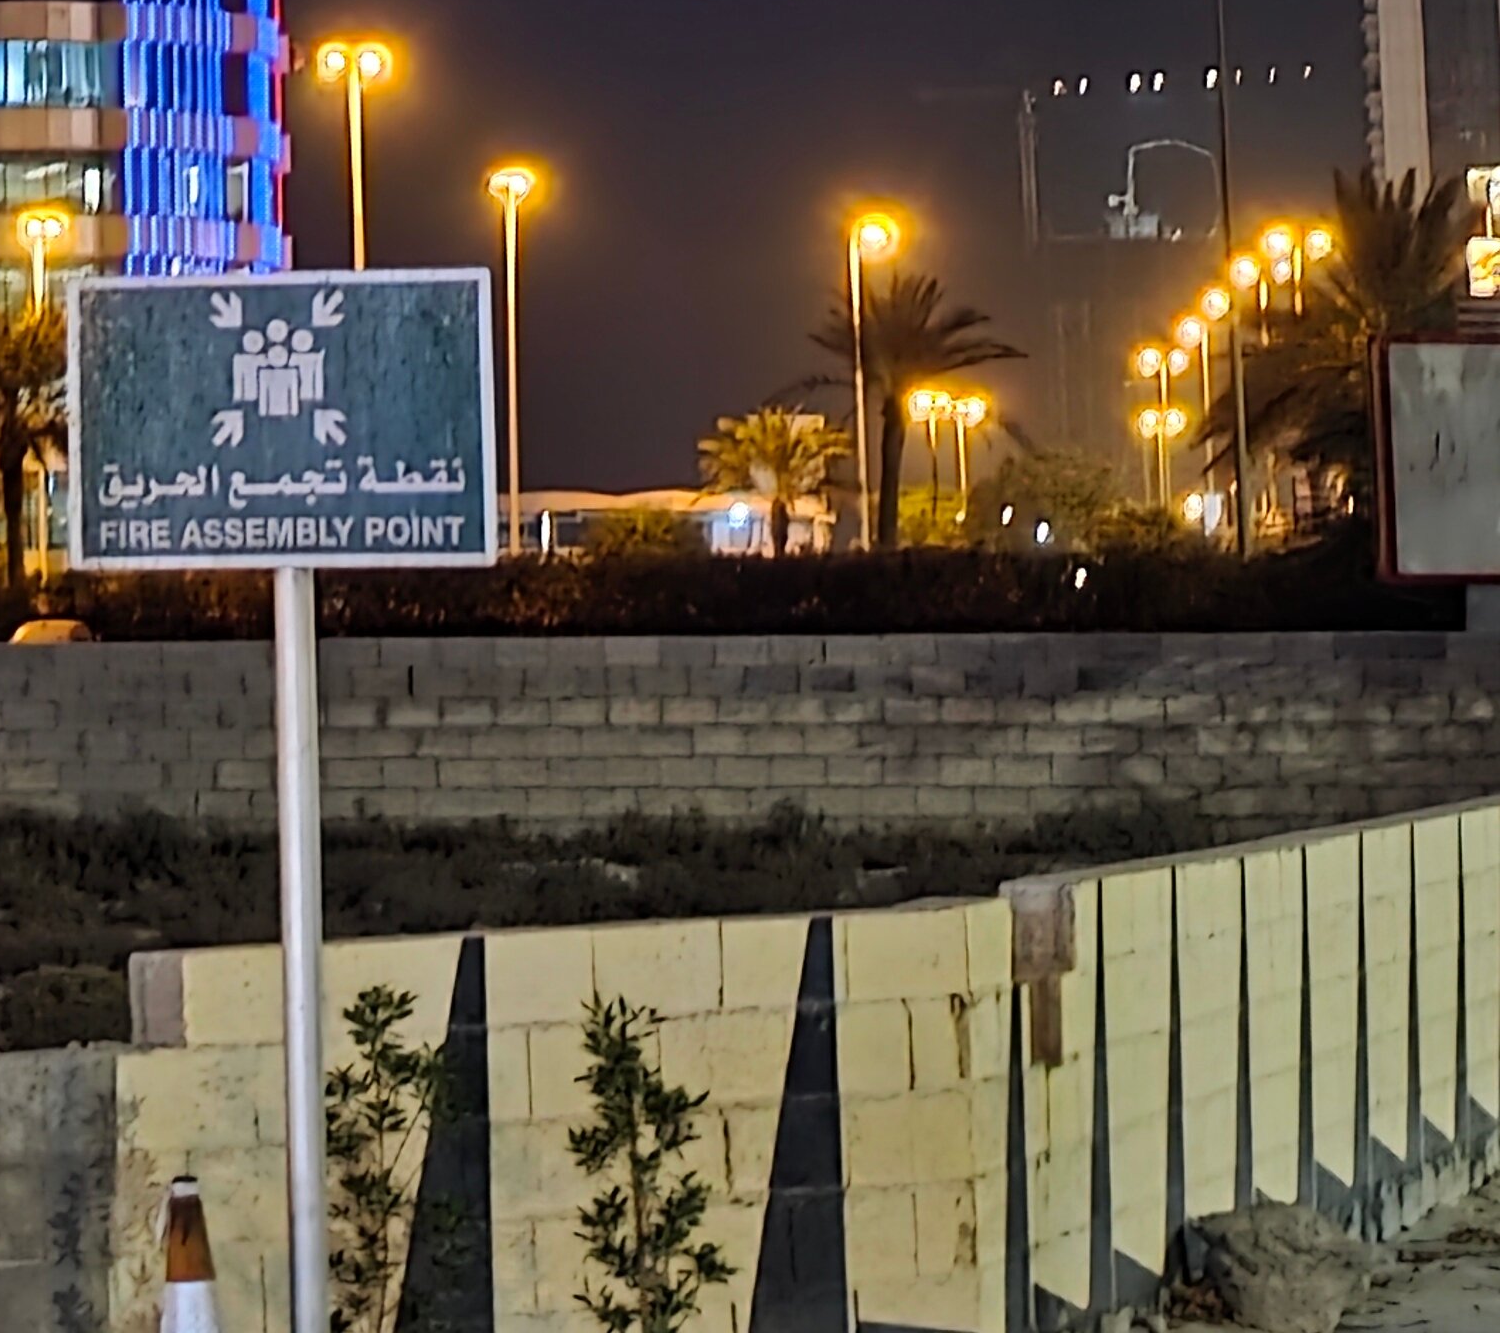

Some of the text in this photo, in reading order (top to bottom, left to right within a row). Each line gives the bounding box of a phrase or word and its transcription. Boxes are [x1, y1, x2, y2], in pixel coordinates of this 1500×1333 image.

[97, 455, 466, 509] نقطة تجمع الحريق
[100, 514, 466, 550] FIRE ASSEMBLY POINT
